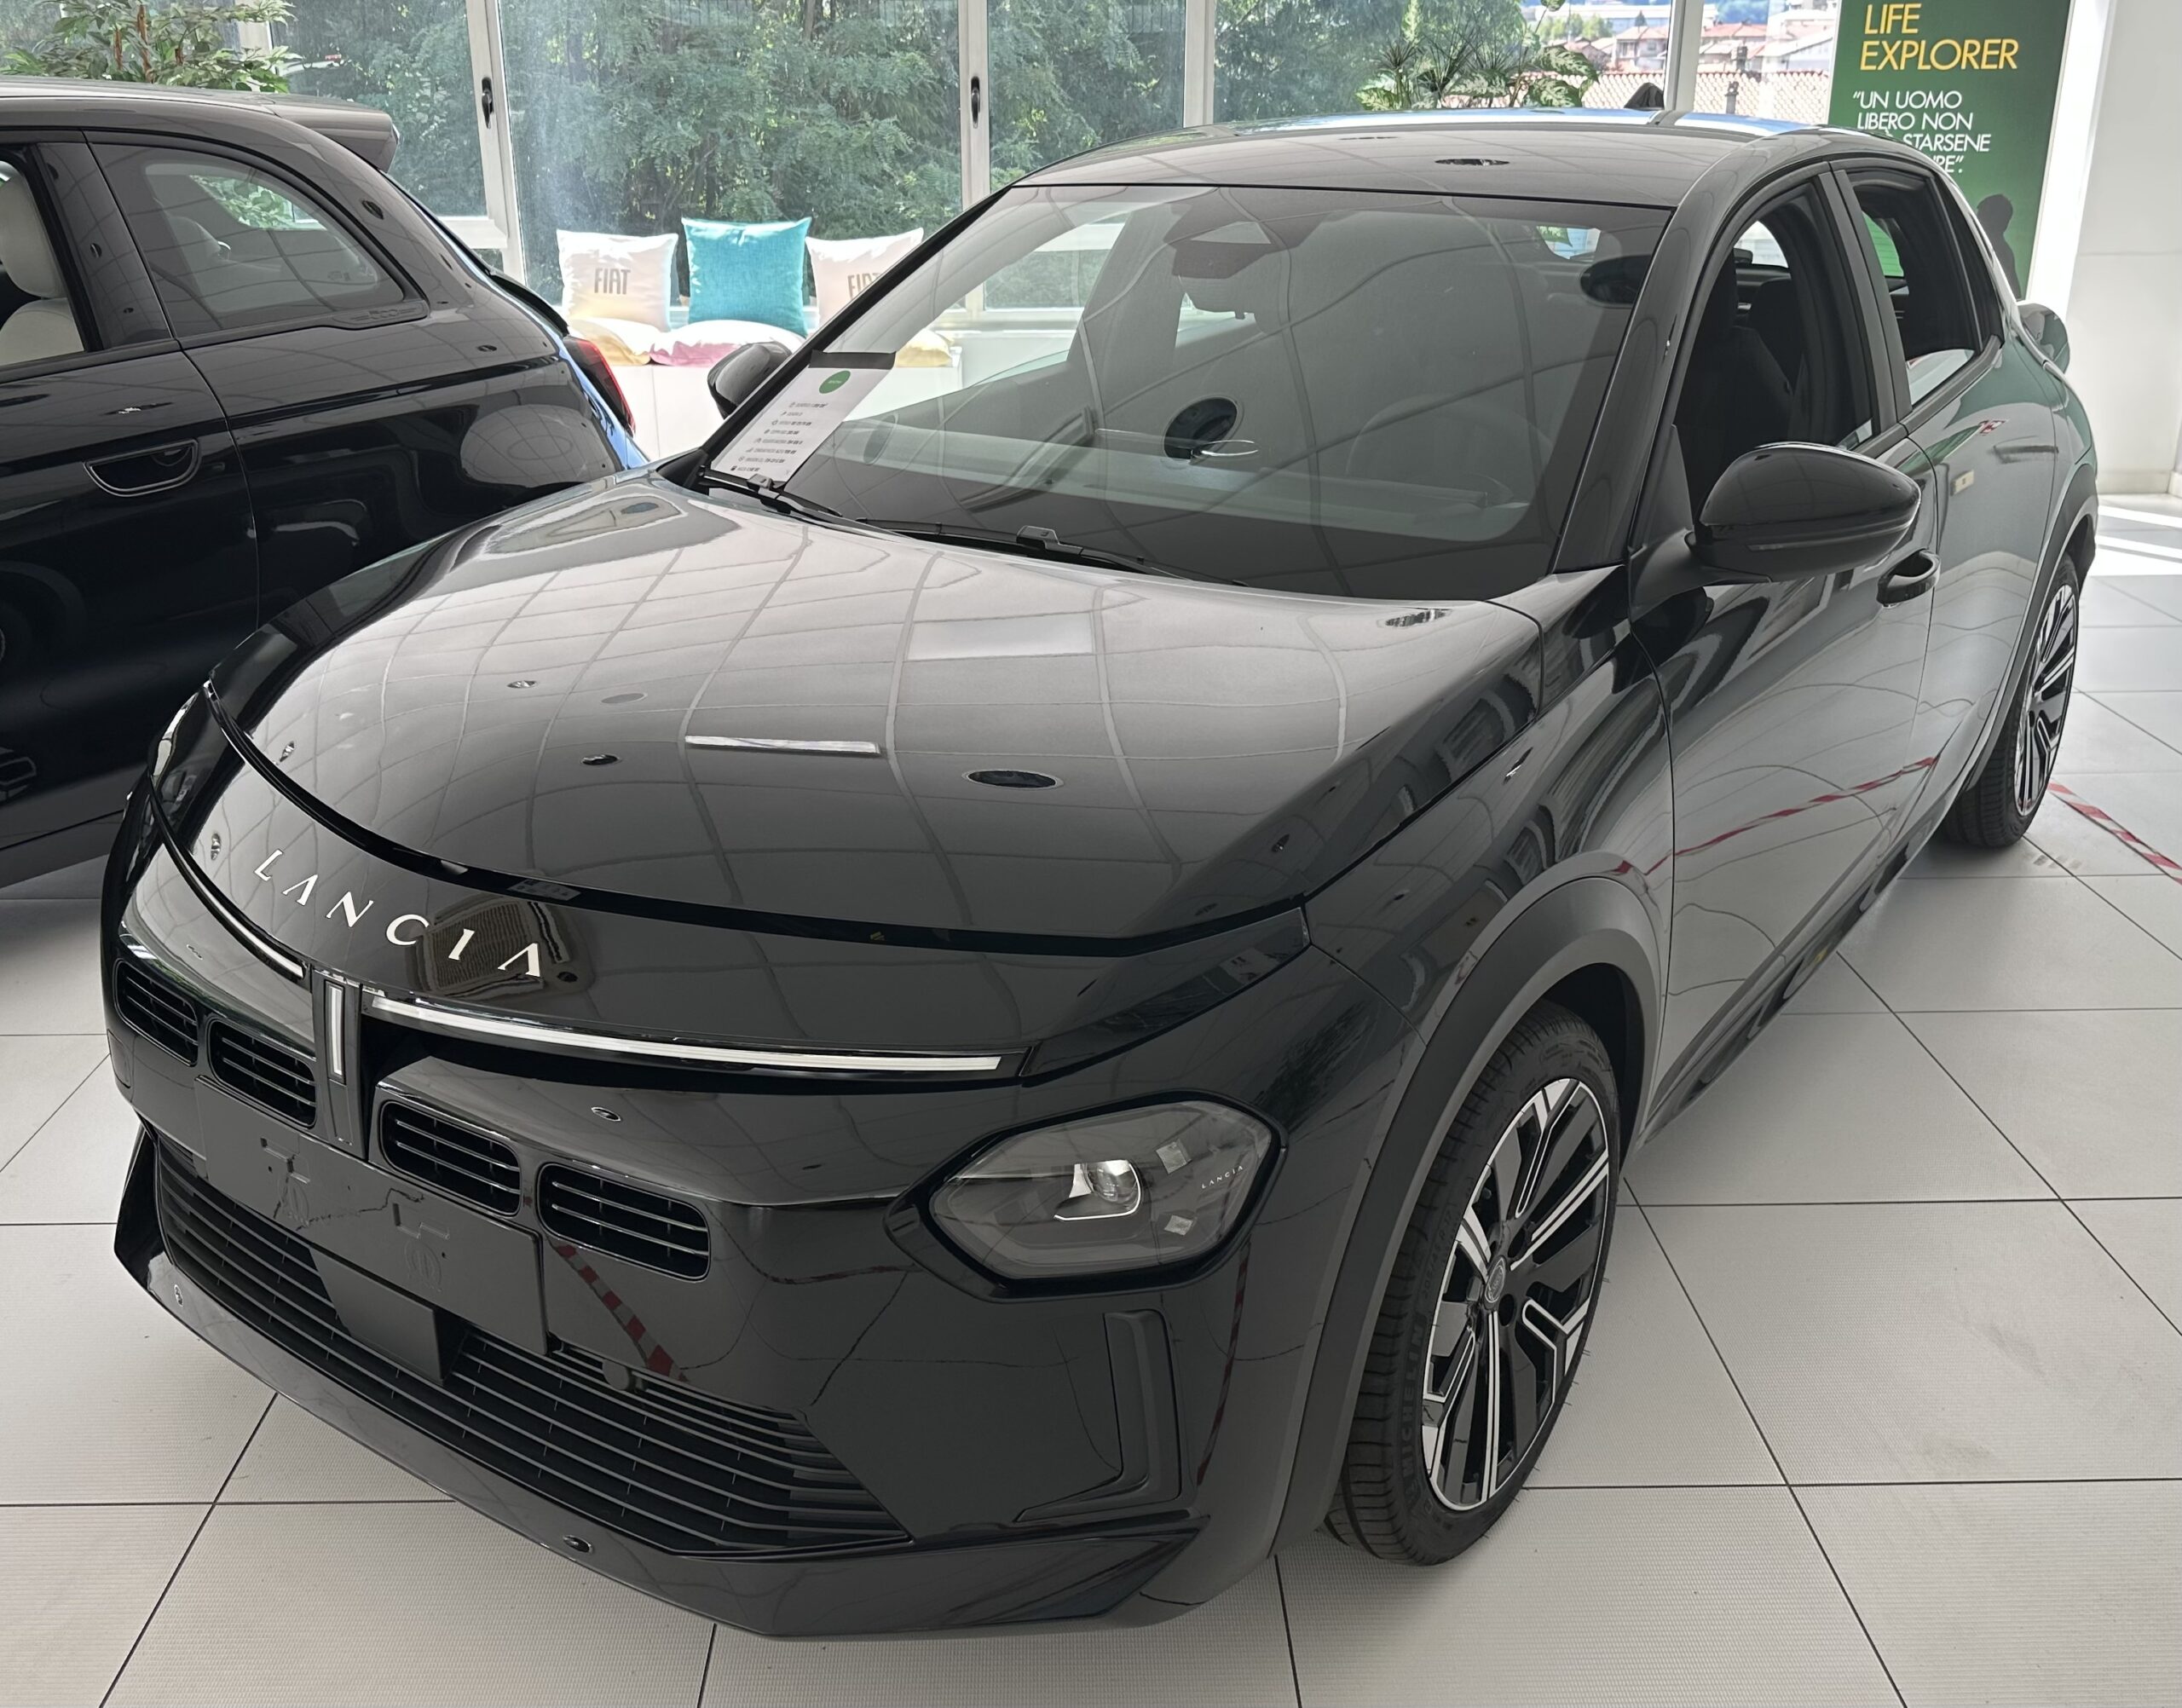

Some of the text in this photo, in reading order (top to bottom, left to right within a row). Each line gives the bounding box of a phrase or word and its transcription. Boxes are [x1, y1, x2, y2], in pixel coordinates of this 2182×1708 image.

[1864, 3, 1921, 35] LIFE
[1860, 38, 2019, 71] EXPLORER
[1895, 90, 1963, 109] UOMO
[1857, 112, 1974, 130] LIBERO NON
[1902, 133, 1992, 152] STARSENE
[594, 268, 632, 295] FIAT
[847, 273, 880, 300] FIA
[254, 849, 541, 978] LANCIA
[1202, 1165, 1244, 1189] LANCIA
[1400, 1324, 1424, 1478] MICHELIN
